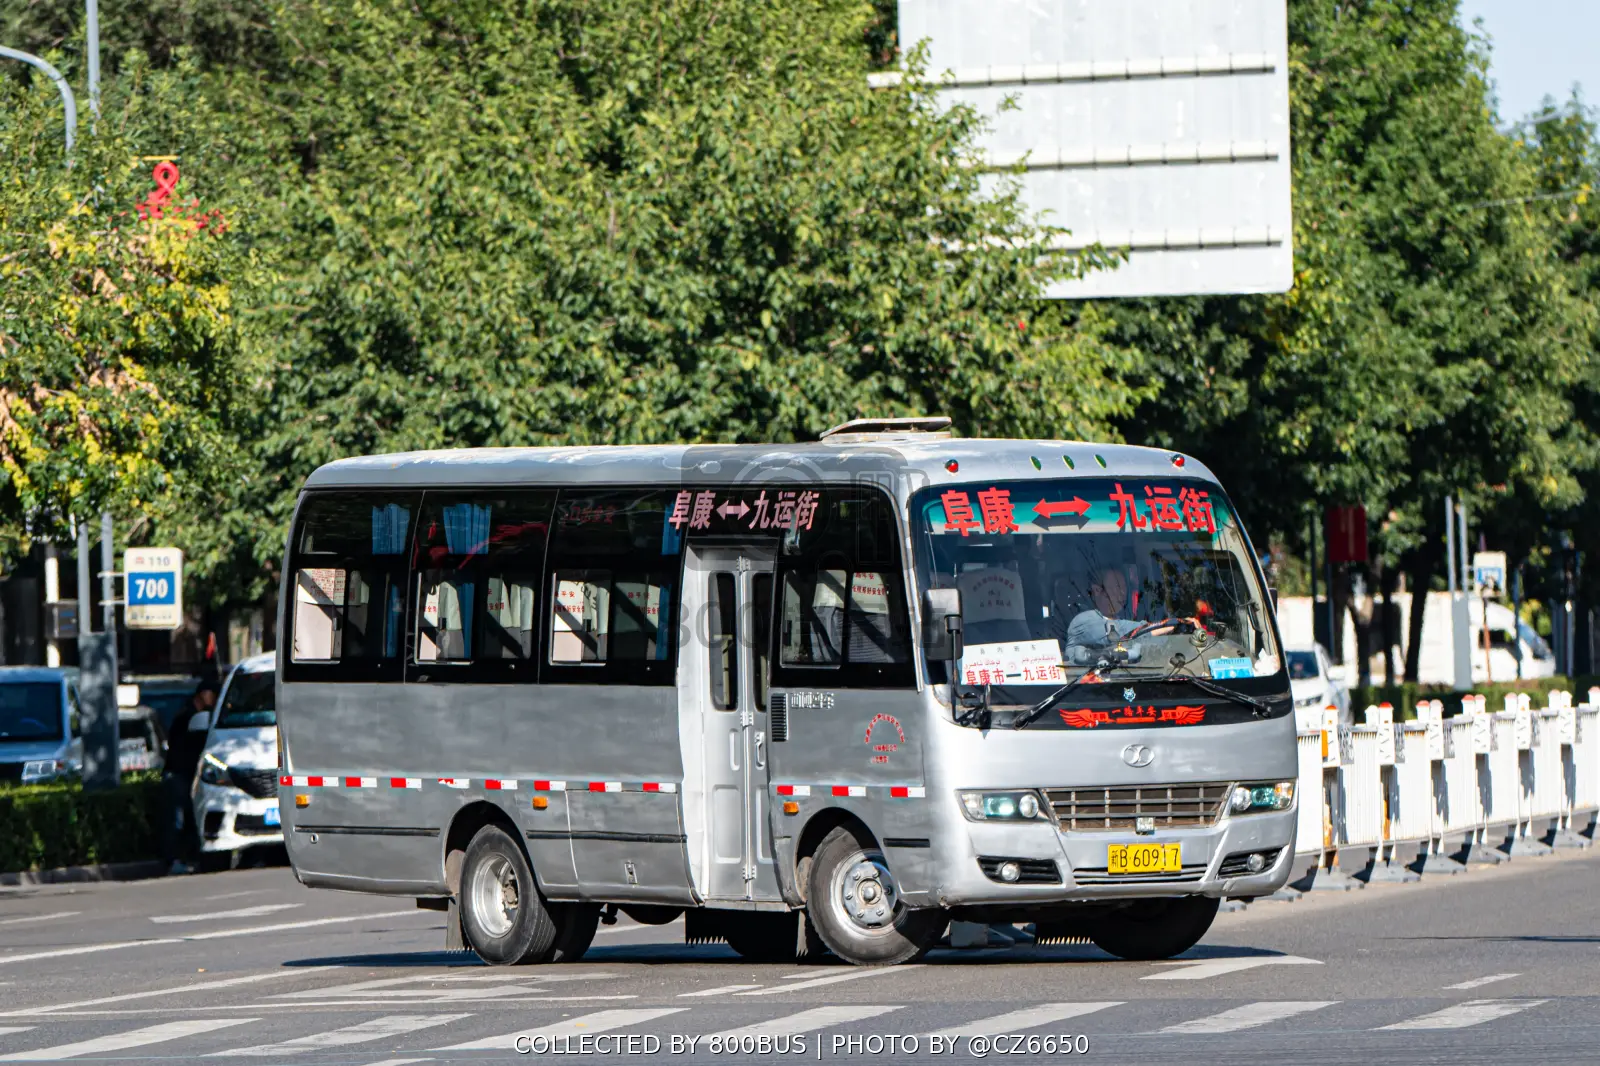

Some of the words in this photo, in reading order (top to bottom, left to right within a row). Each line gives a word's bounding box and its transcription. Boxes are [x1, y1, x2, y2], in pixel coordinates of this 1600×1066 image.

[668, 489, 717, 531] 阜康
[748, 489, 820, 531] 九运街
[940, 487, 1020, 537] 阜康
[1109, 483, 1217, 534] 九运街
[135, 578, 168, 599] 700
